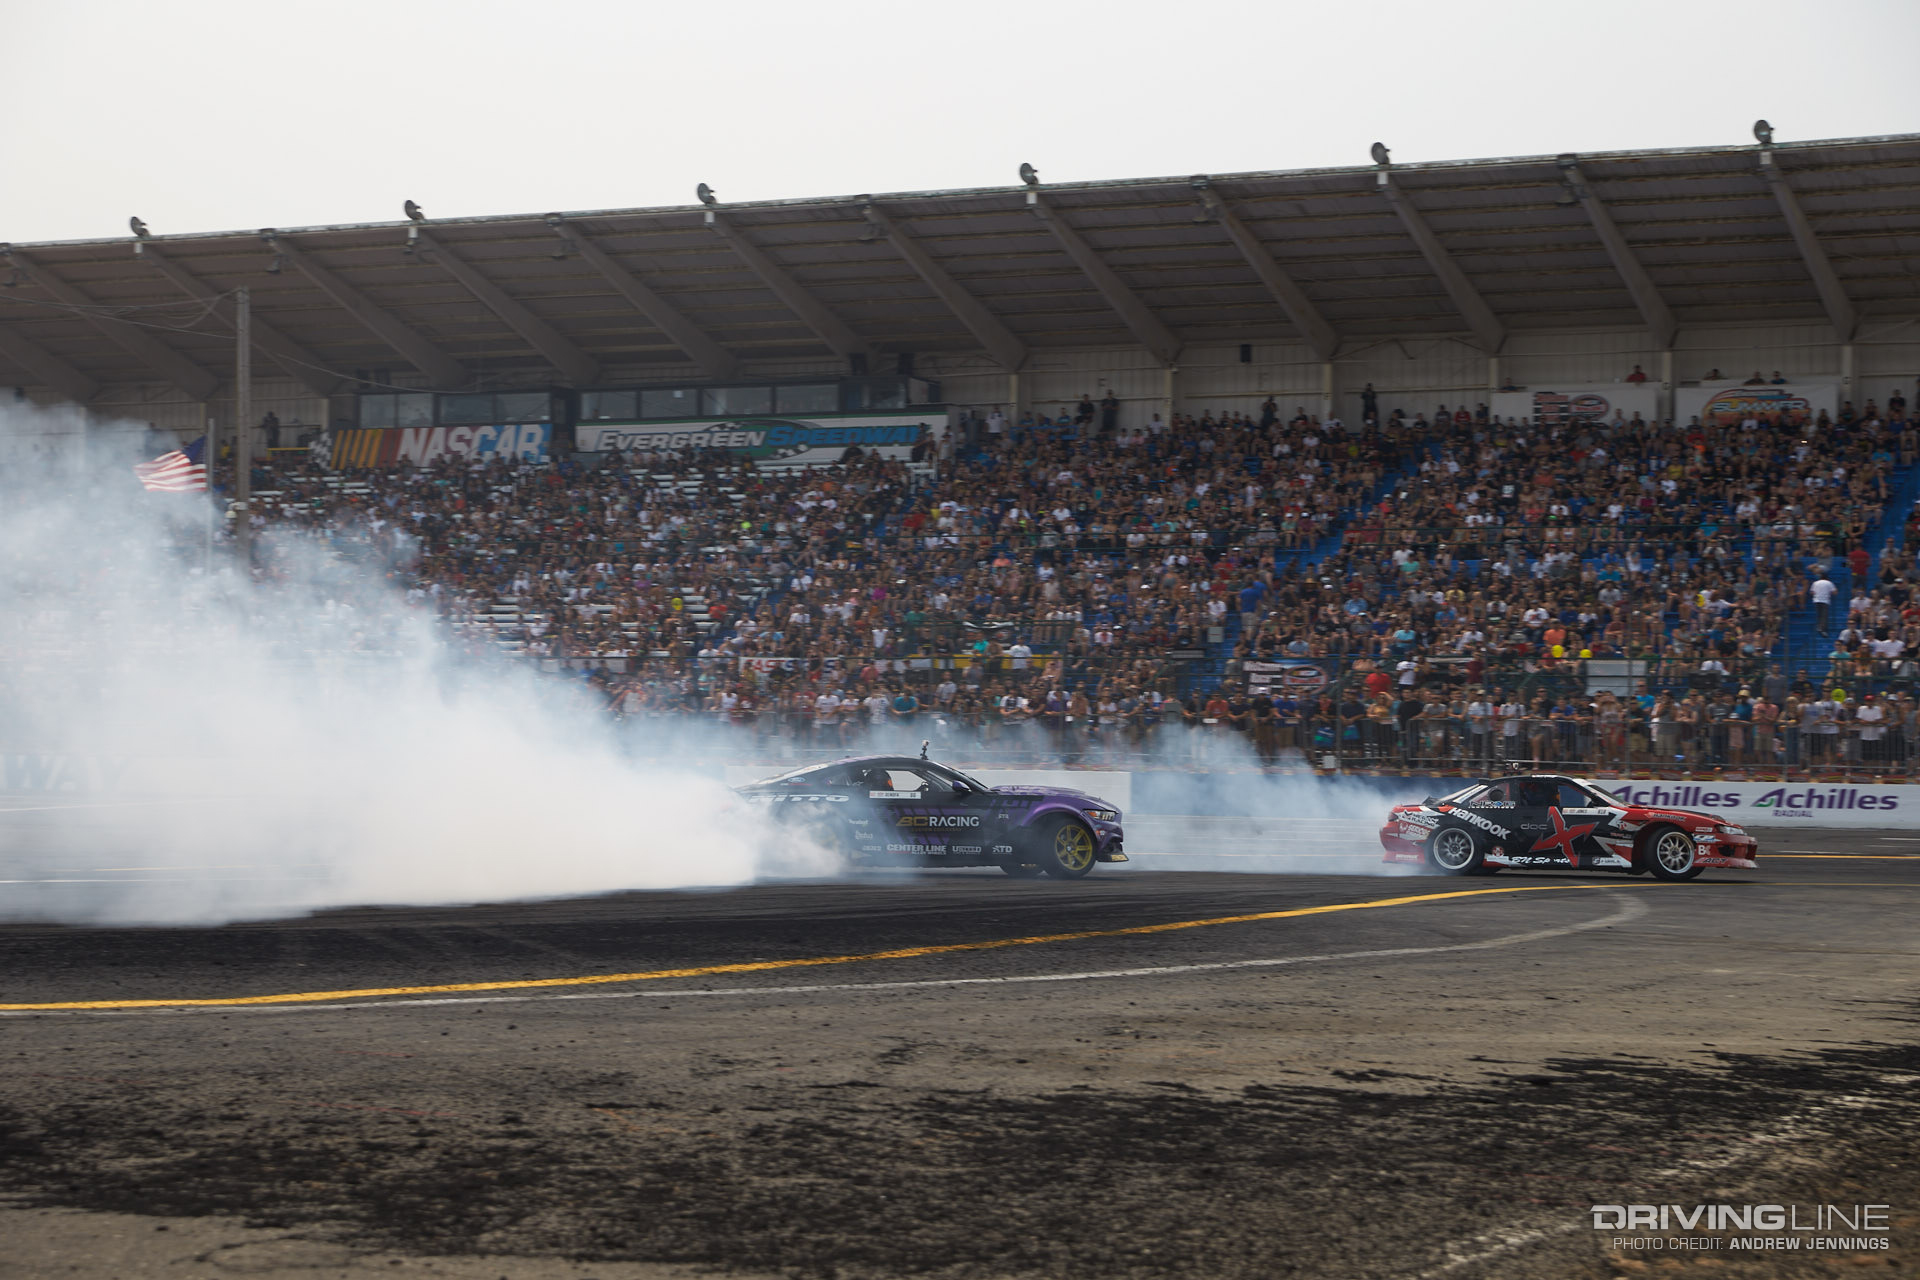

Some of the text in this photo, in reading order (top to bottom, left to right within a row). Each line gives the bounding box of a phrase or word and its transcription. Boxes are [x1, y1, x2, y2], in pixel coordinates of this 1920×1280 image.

[1711, 400, 1805, 413] SUMMER
[396, 424, 545, 467] NASCAR
[596, 430, 767, 451] EVERGREEN
[1613, 785, 1740, 807] Achilles
[1751, 787, 1899, 811] Achilles
[1772, 809, 1814, 818] RADIAL
[929, 816, 980, 827] RACING
[886, 844, 924, 852] CENTER
[926, 844, 947, 852] LINE
[1532, 856, 1570, 864] Sprts
